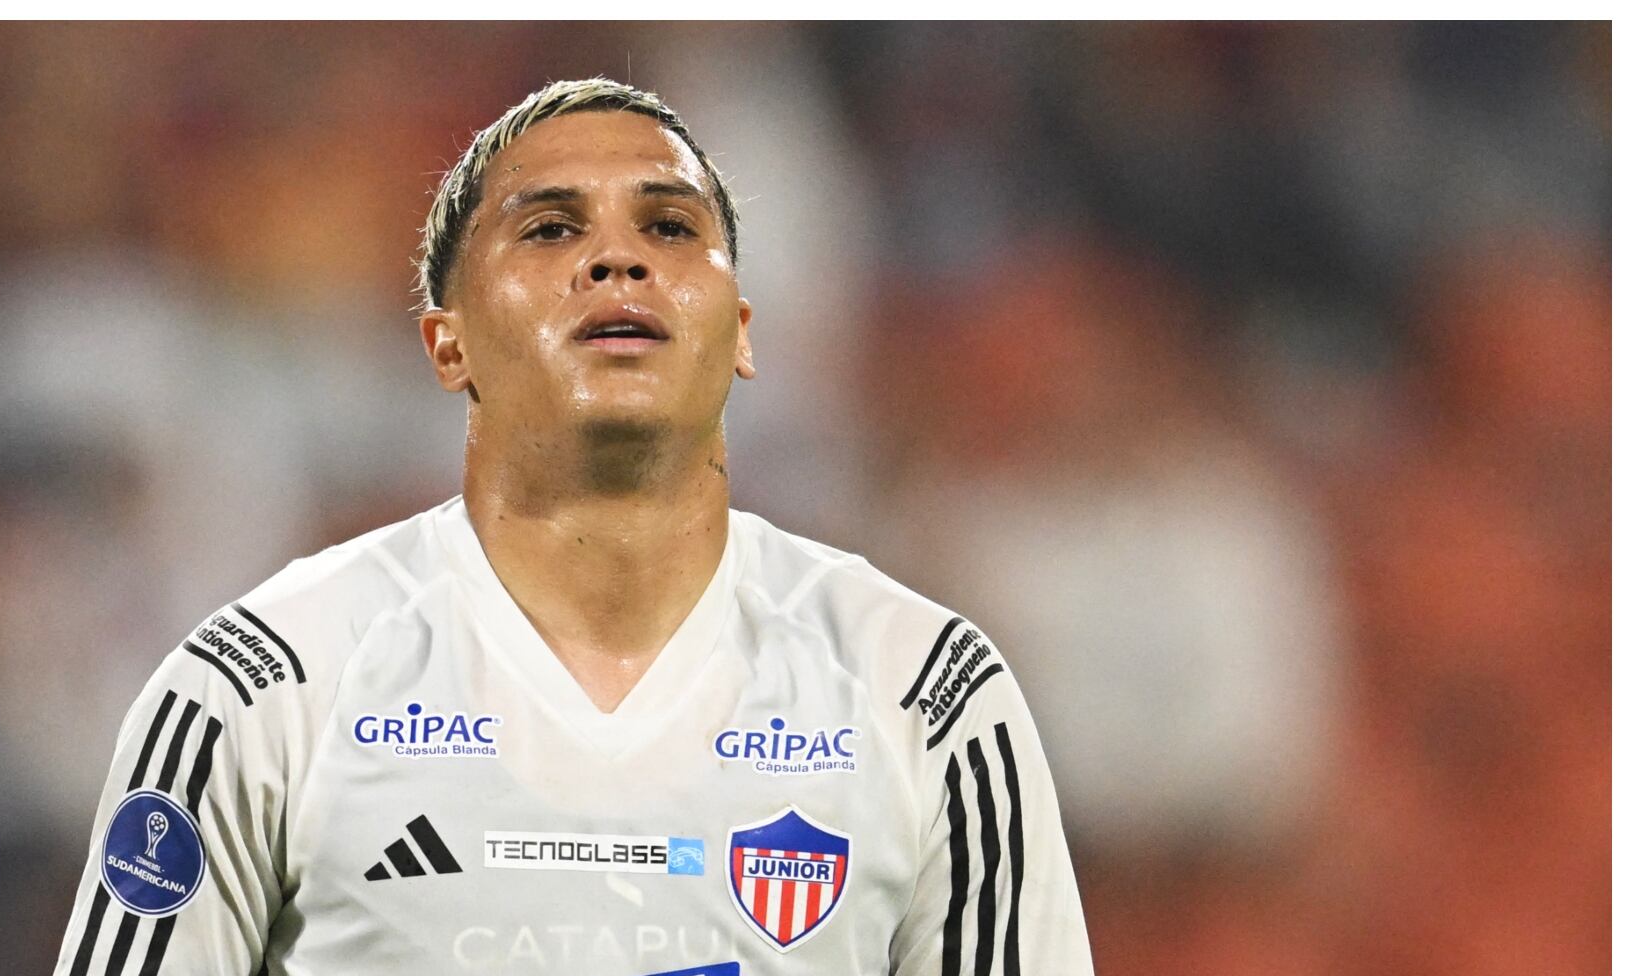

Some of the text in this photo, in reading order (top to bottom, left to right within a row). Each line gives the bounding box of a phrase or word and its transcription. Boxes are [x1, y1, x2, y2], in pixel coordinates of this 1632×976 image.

[195, 626, 269, 690] ntioqueño
[209, 613, 286, 683] guardiente
[452, 744, 497, 756] Blanda
[813, 759, 856, 772] Blanda
[106, 855, 187, 895] SUDAMERICANA
[747, 858, 830, 881] JUNIOR
